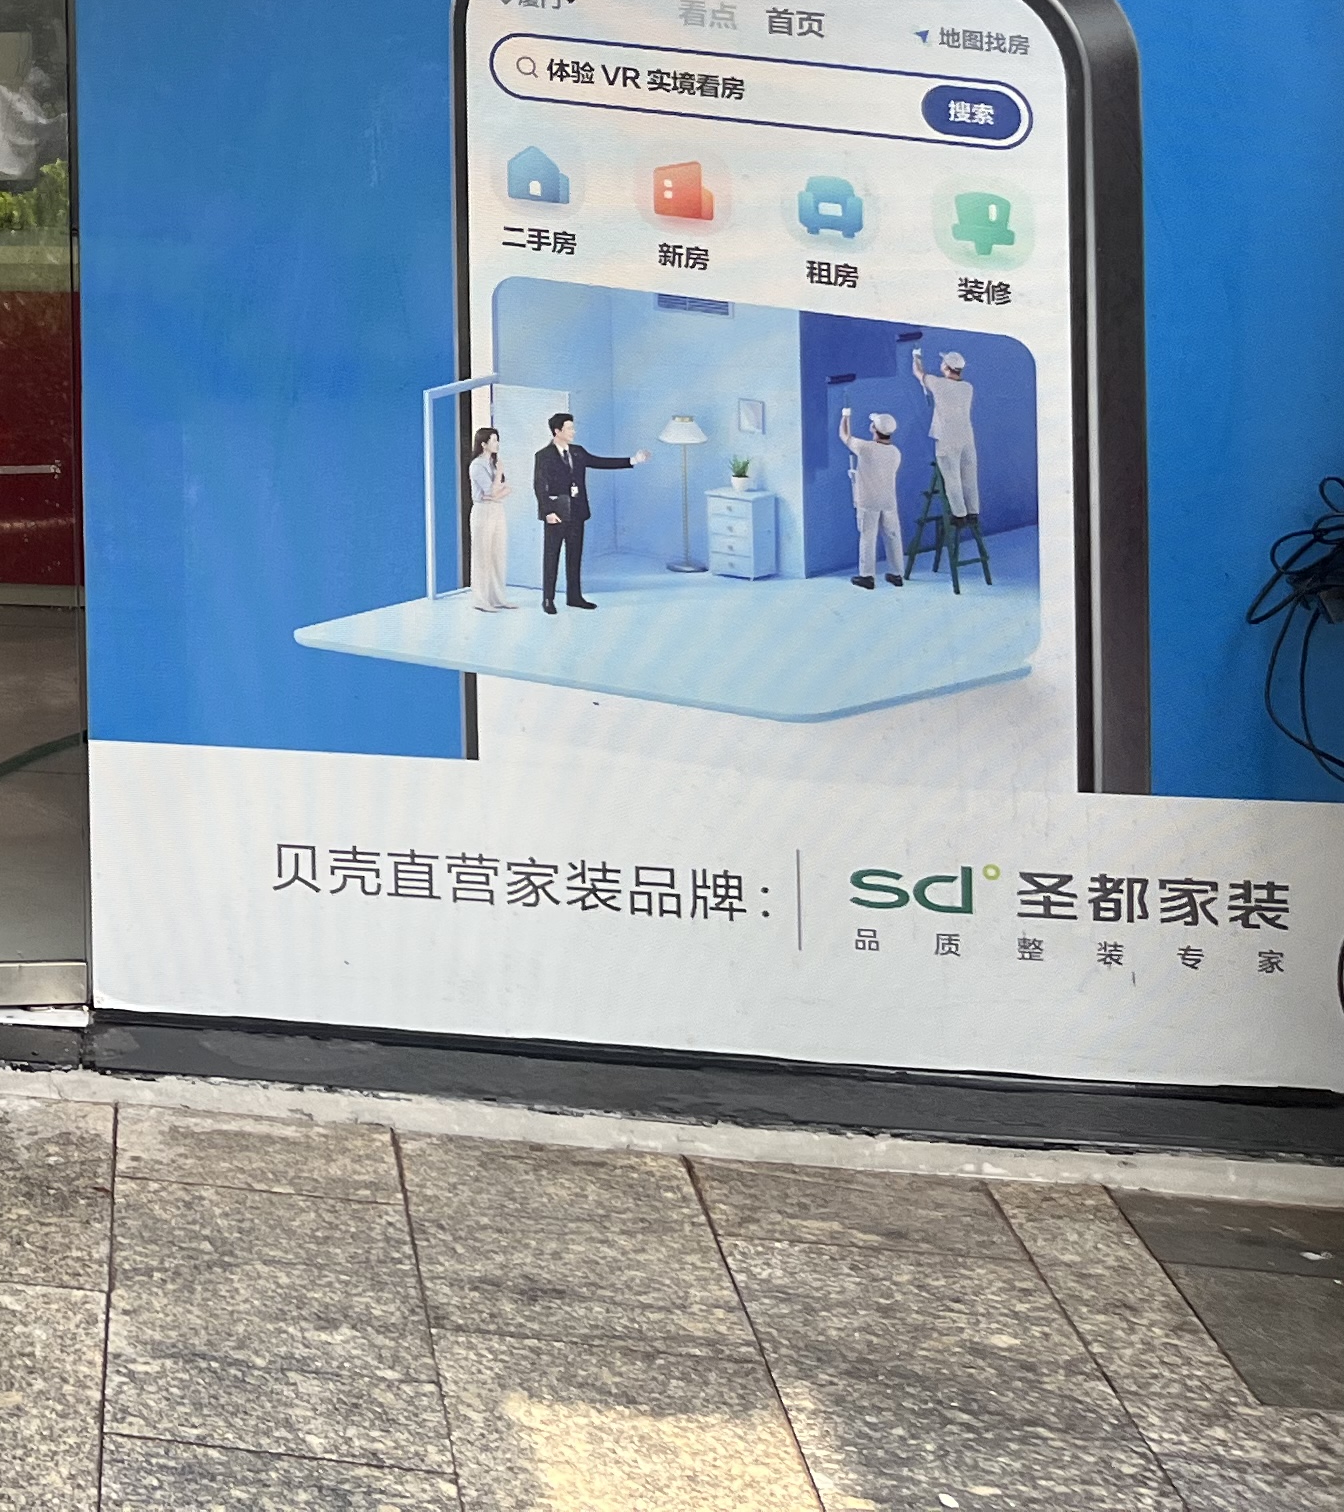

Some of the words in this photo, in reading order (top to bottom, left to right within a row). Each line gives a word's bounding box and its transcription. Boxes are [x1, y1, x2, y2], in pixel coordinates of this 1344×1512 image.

[765, 6, 826, 40] 首页
[938, 28, 1031, 58] 地图找房
[547, 59, 596, 88] 体验
[601, 64, 642, 91] VR
[646, 68, 746, 102] 实境看房
[947, 99, 996, 127] 搜索
[501, 226, 579, 258] 二手房
[657, 242, 710, 272] 新房
[806, 259, 859, 290] 租房
[957, 276, 1013, 307] 装修
[272, 841, 774, 923] 贝壳直营家装品牌：
[1016, 869, 1292, 932] 圣都家装
[853, 927, 1287, 976] 品质整装专家
